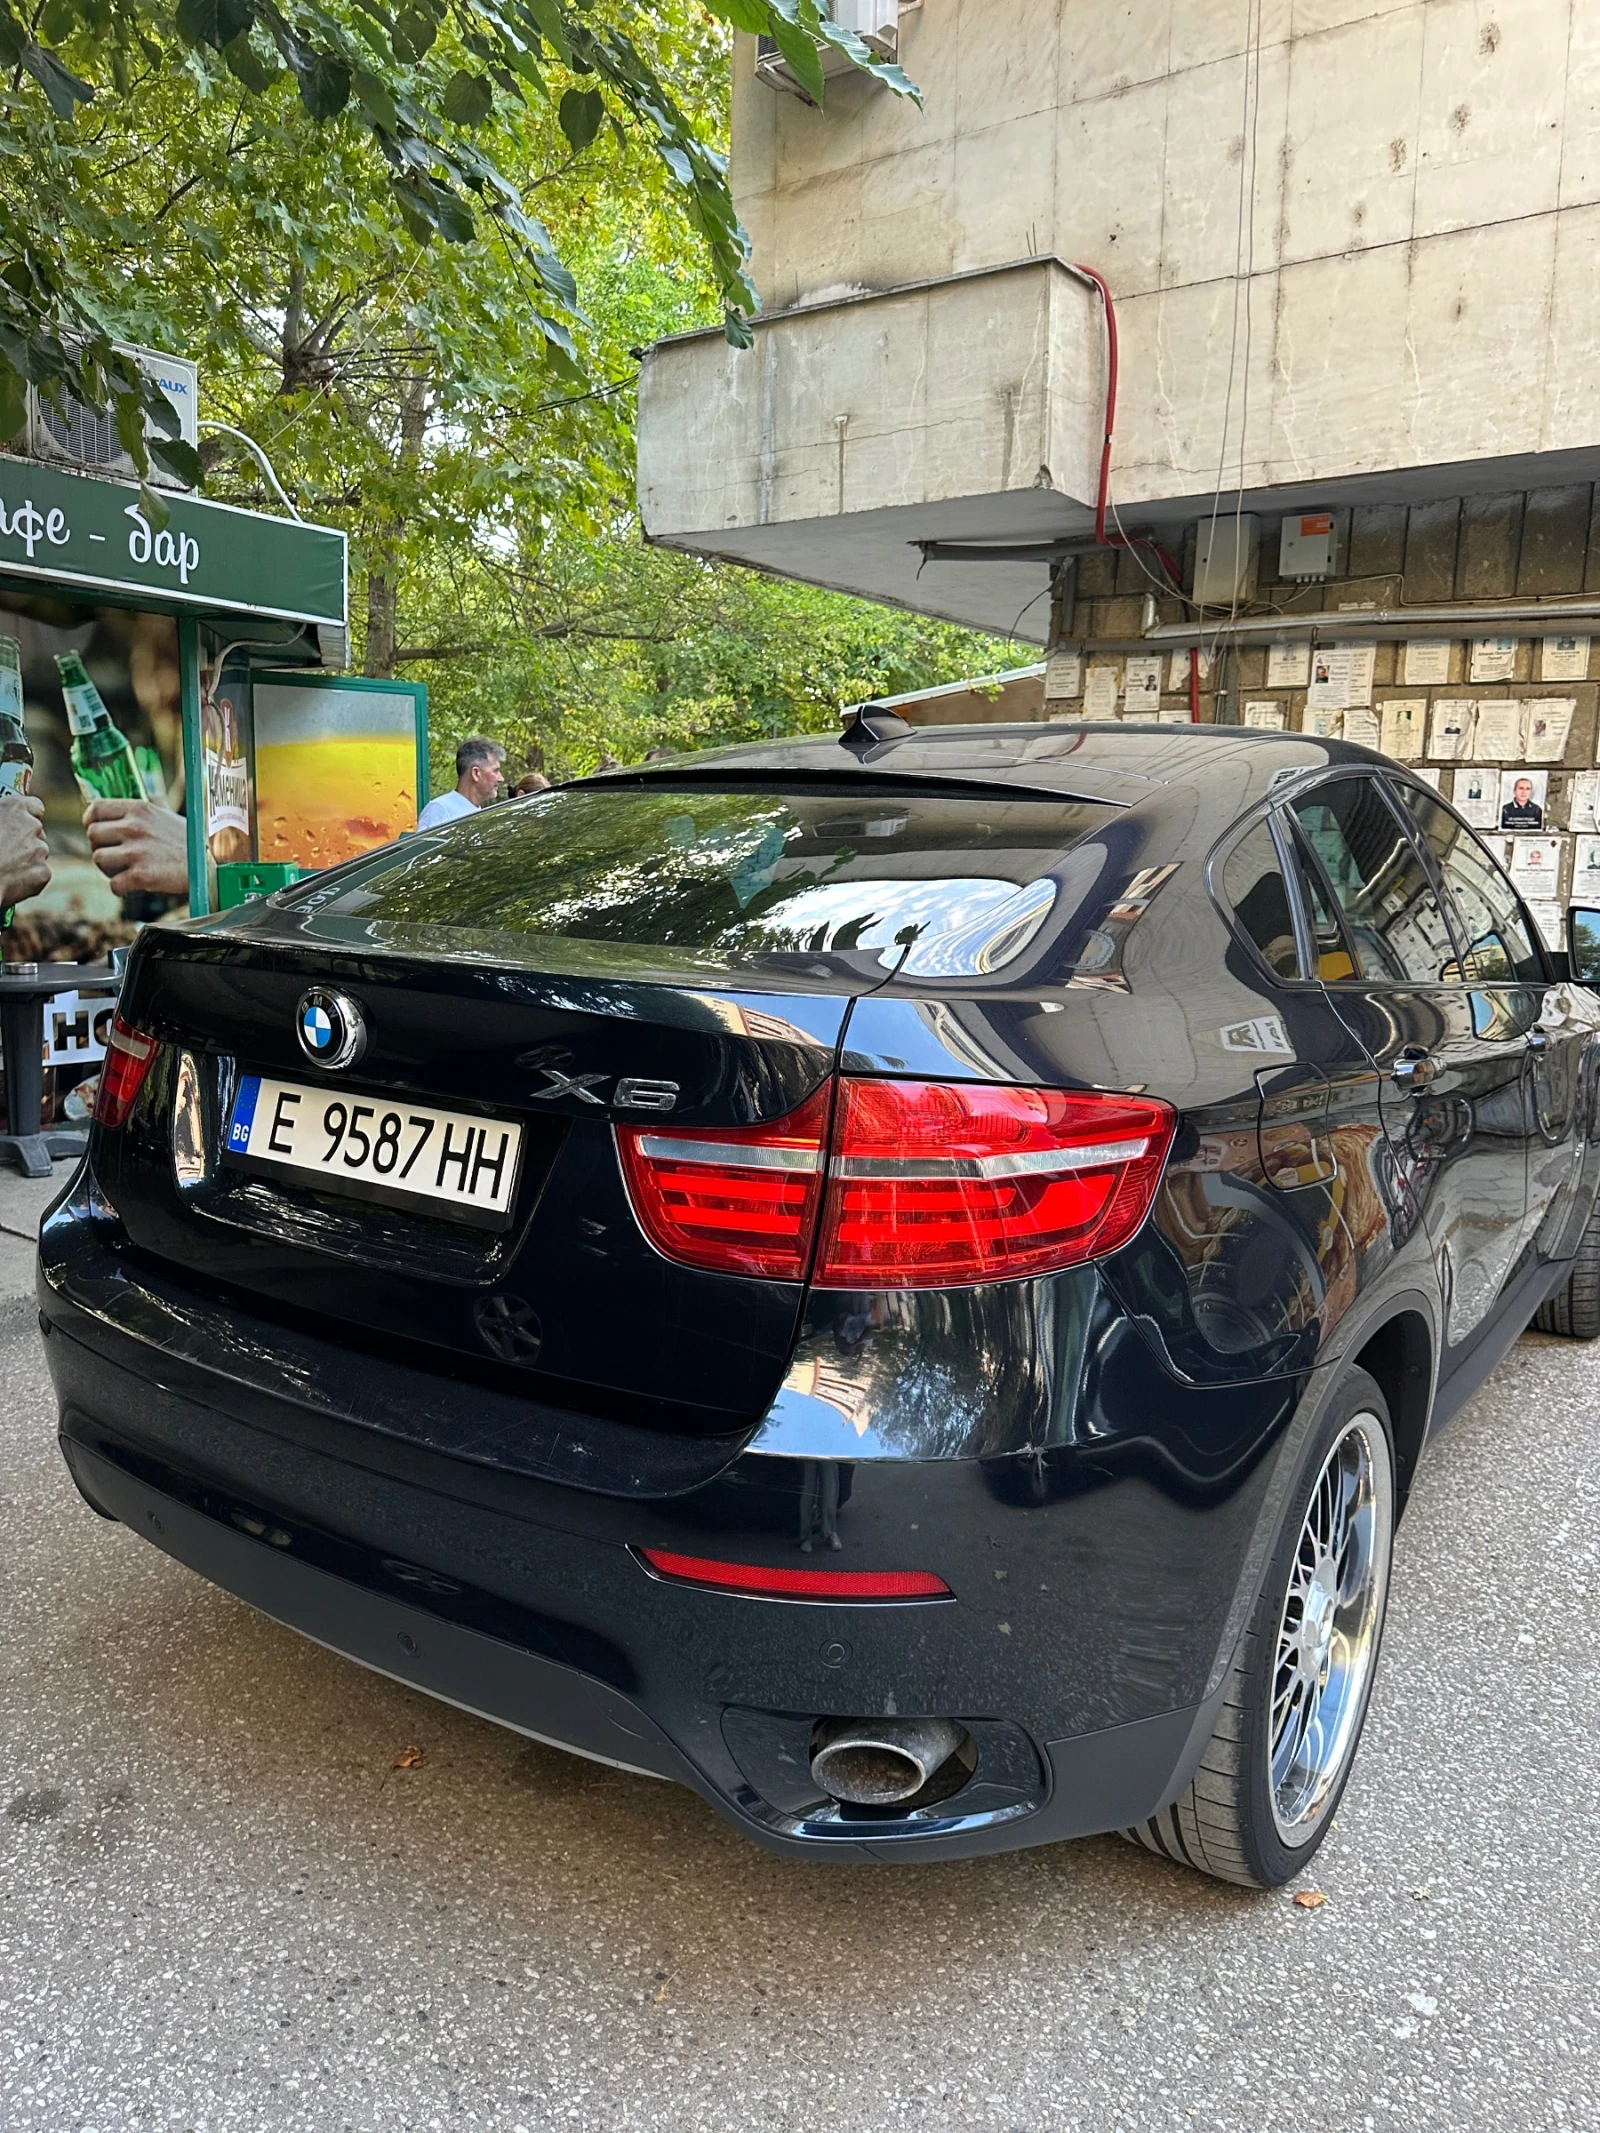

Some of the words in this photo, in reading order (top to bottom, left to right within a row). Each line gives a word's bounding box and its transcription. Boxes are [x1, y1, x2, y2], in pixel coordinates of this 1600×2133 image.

[158, 378, 188, 394] AUX
[124, 503, 200, 585] бар
[301, 994, 338, 1019] BMW
[529, 1069, 681, 1111] X6
[231, 1122, 249, 1143] BG
[267, 1091, 302, 1155] E
[321, 1101, 435, 1179] 9587
